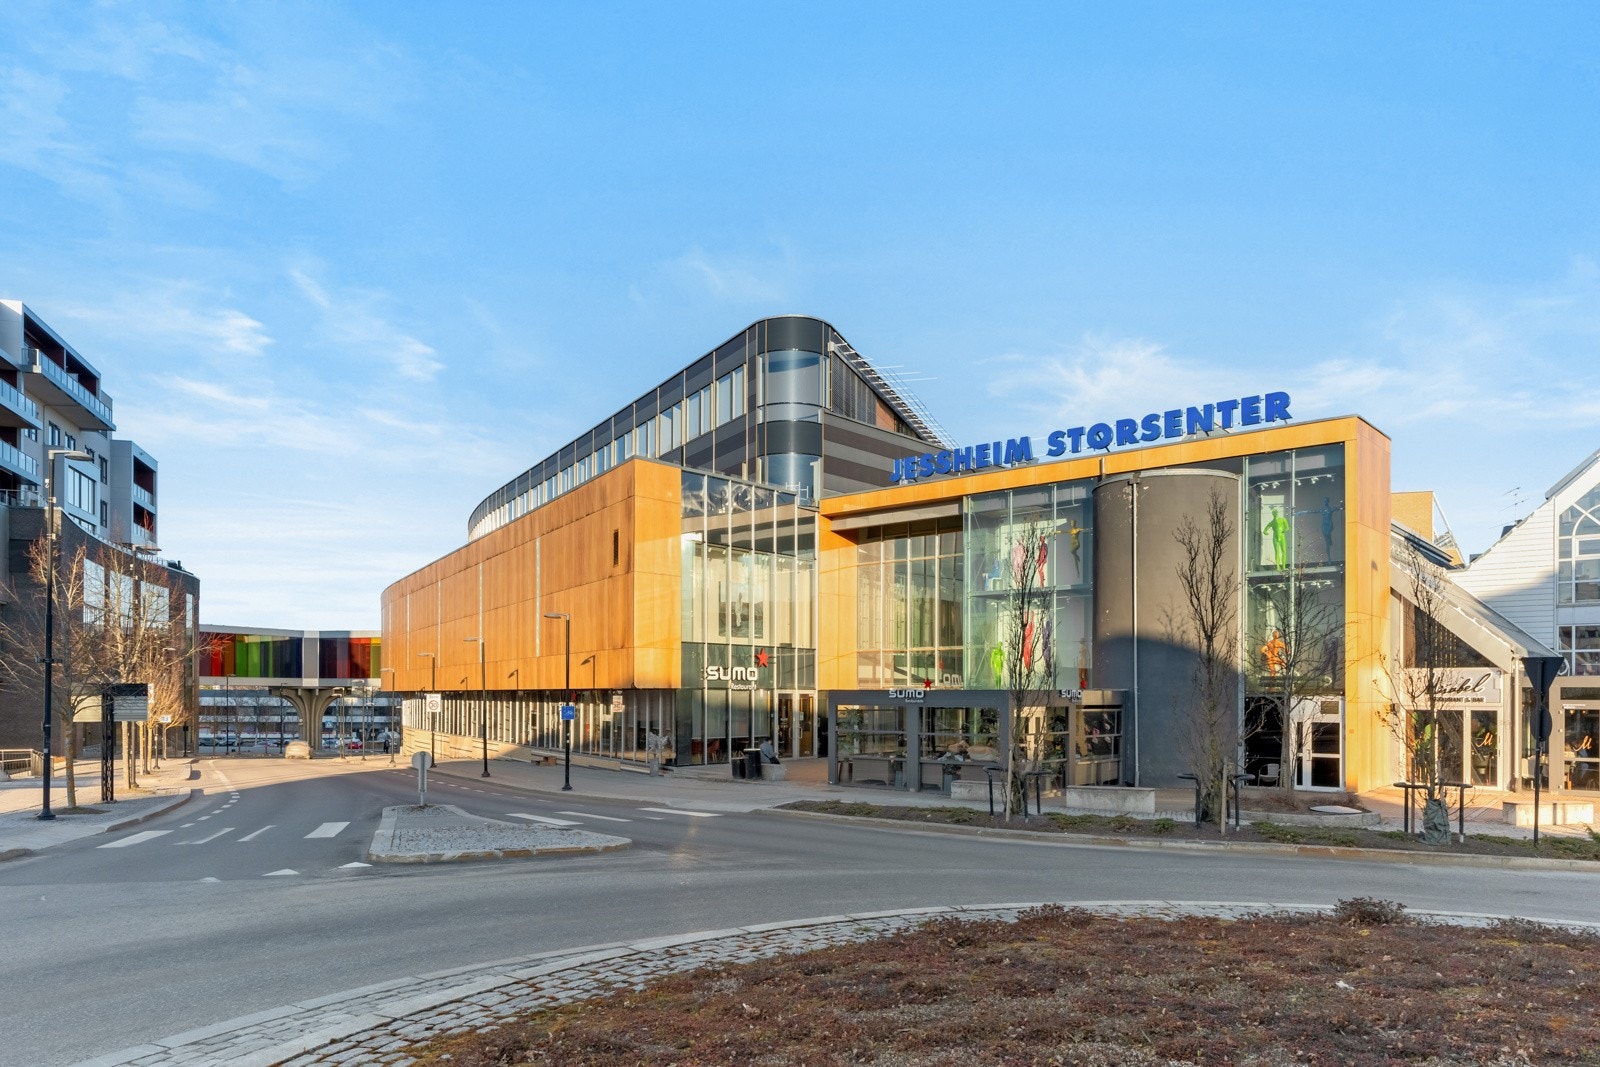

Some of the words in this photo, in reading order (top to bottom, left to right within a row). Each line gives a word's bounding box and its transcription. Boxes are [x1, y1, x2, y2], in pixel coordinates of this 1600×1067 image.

[889, 436, 1034, 483] JESSHEIM
[1046, 391, 1292, 457] STORSENTER
[706, 665, 758, 681] SUMO
[888, 688, 925, 698] SUMO
